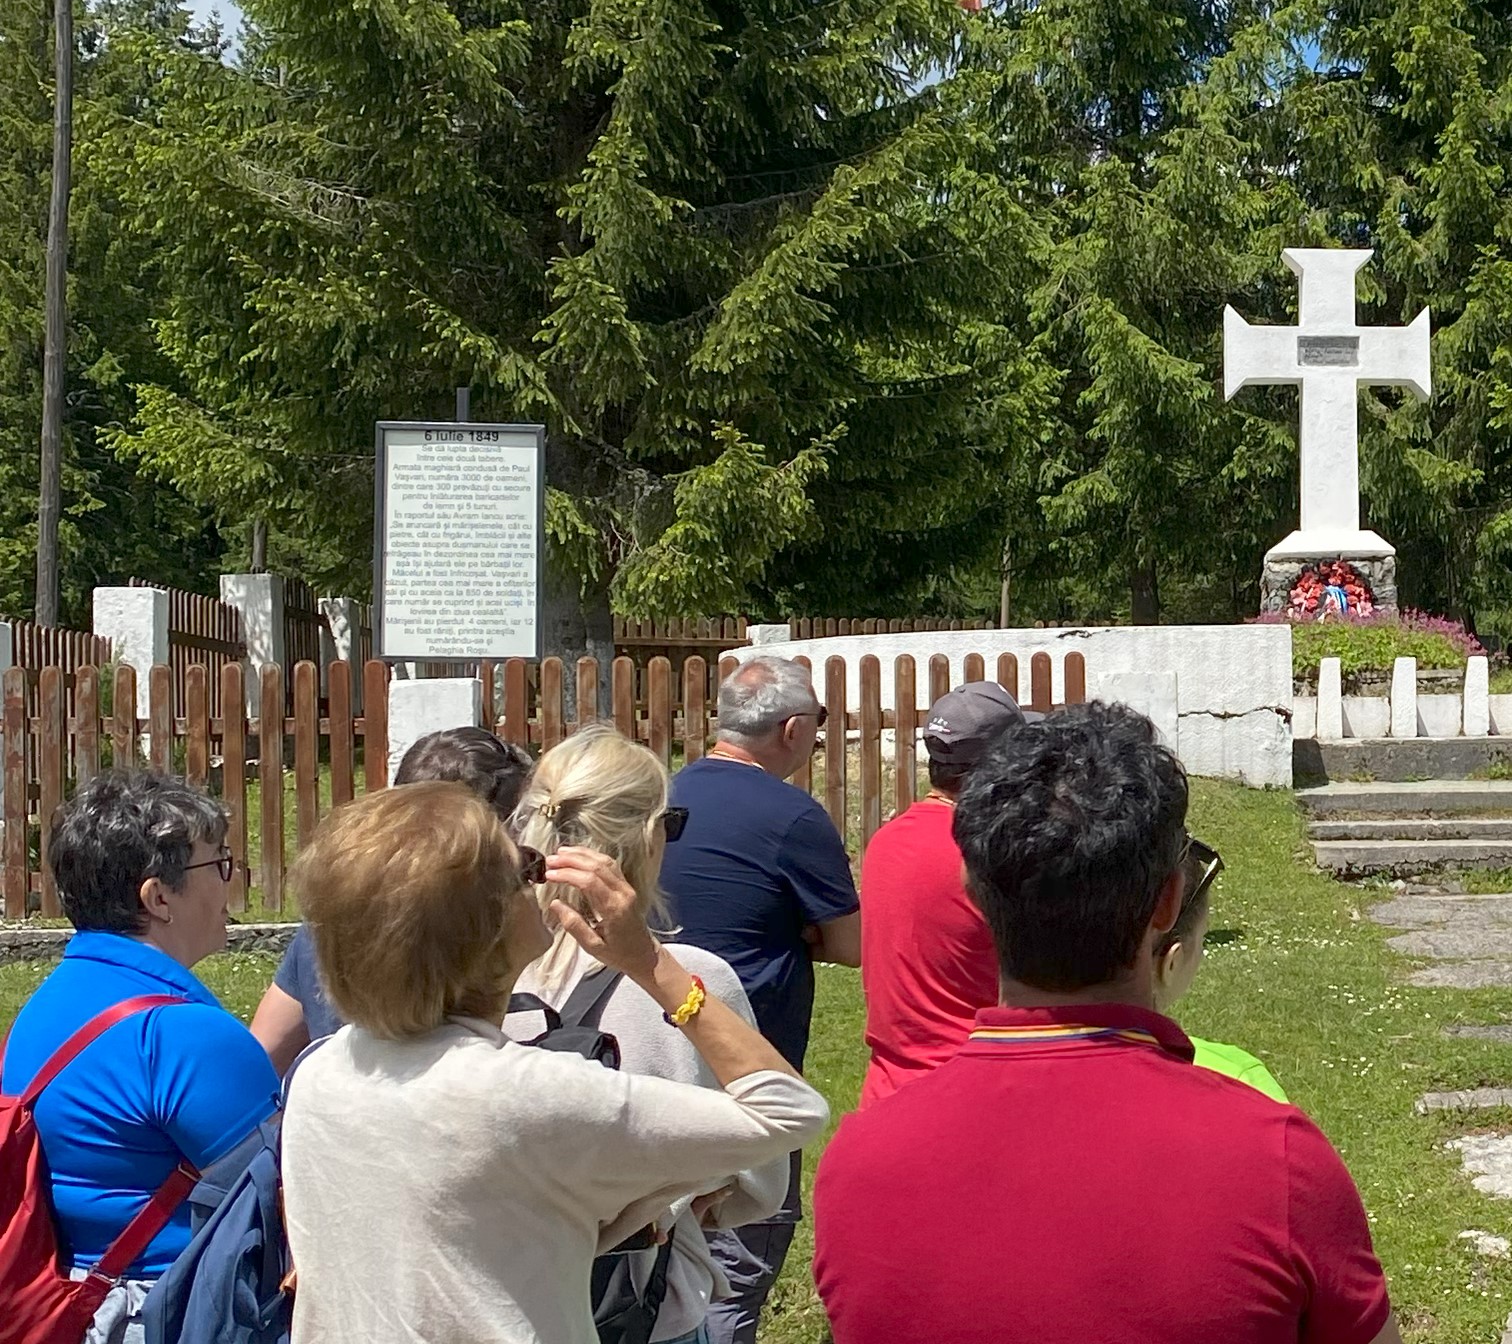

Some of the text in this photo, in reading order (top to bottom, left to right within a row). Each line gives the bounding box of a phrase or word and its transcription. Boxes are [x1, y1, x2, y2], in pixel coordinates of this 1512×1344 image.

[424, 431, 499, 441] 6 Iulie 1849
[421, 445, 432, 453] Se
[499, 464, 509, 472] de
[512, 464, 530, 472] Paul
[416, 483, 433, 492] care
[436, 483, 451, 492] 300
[492, 483, 501, 492] cu
[423, 502, 433, 511] de
[466, 502, 471, 511] 5
[453, 510, 479, 519] Avram
[522, 521, 532, 529] cu
[468, 560, 478, 569] pe
[425, 569, 431, 578] a
[523, 569, 528, 578] a
[408, 589, 418, 597] cu
[444, 589, 454, 597] ca
[456, 589, 464, 597] la
[466, 589, 480, 597] 850
[483, 589, 493, 597] de
[432, 599, 442, 607] se
[424, 618, 434, 626] au
[469, 618, 474, 626] 4
[525, 618, 533, 626] 12
[404, 627, 414, 636] au
